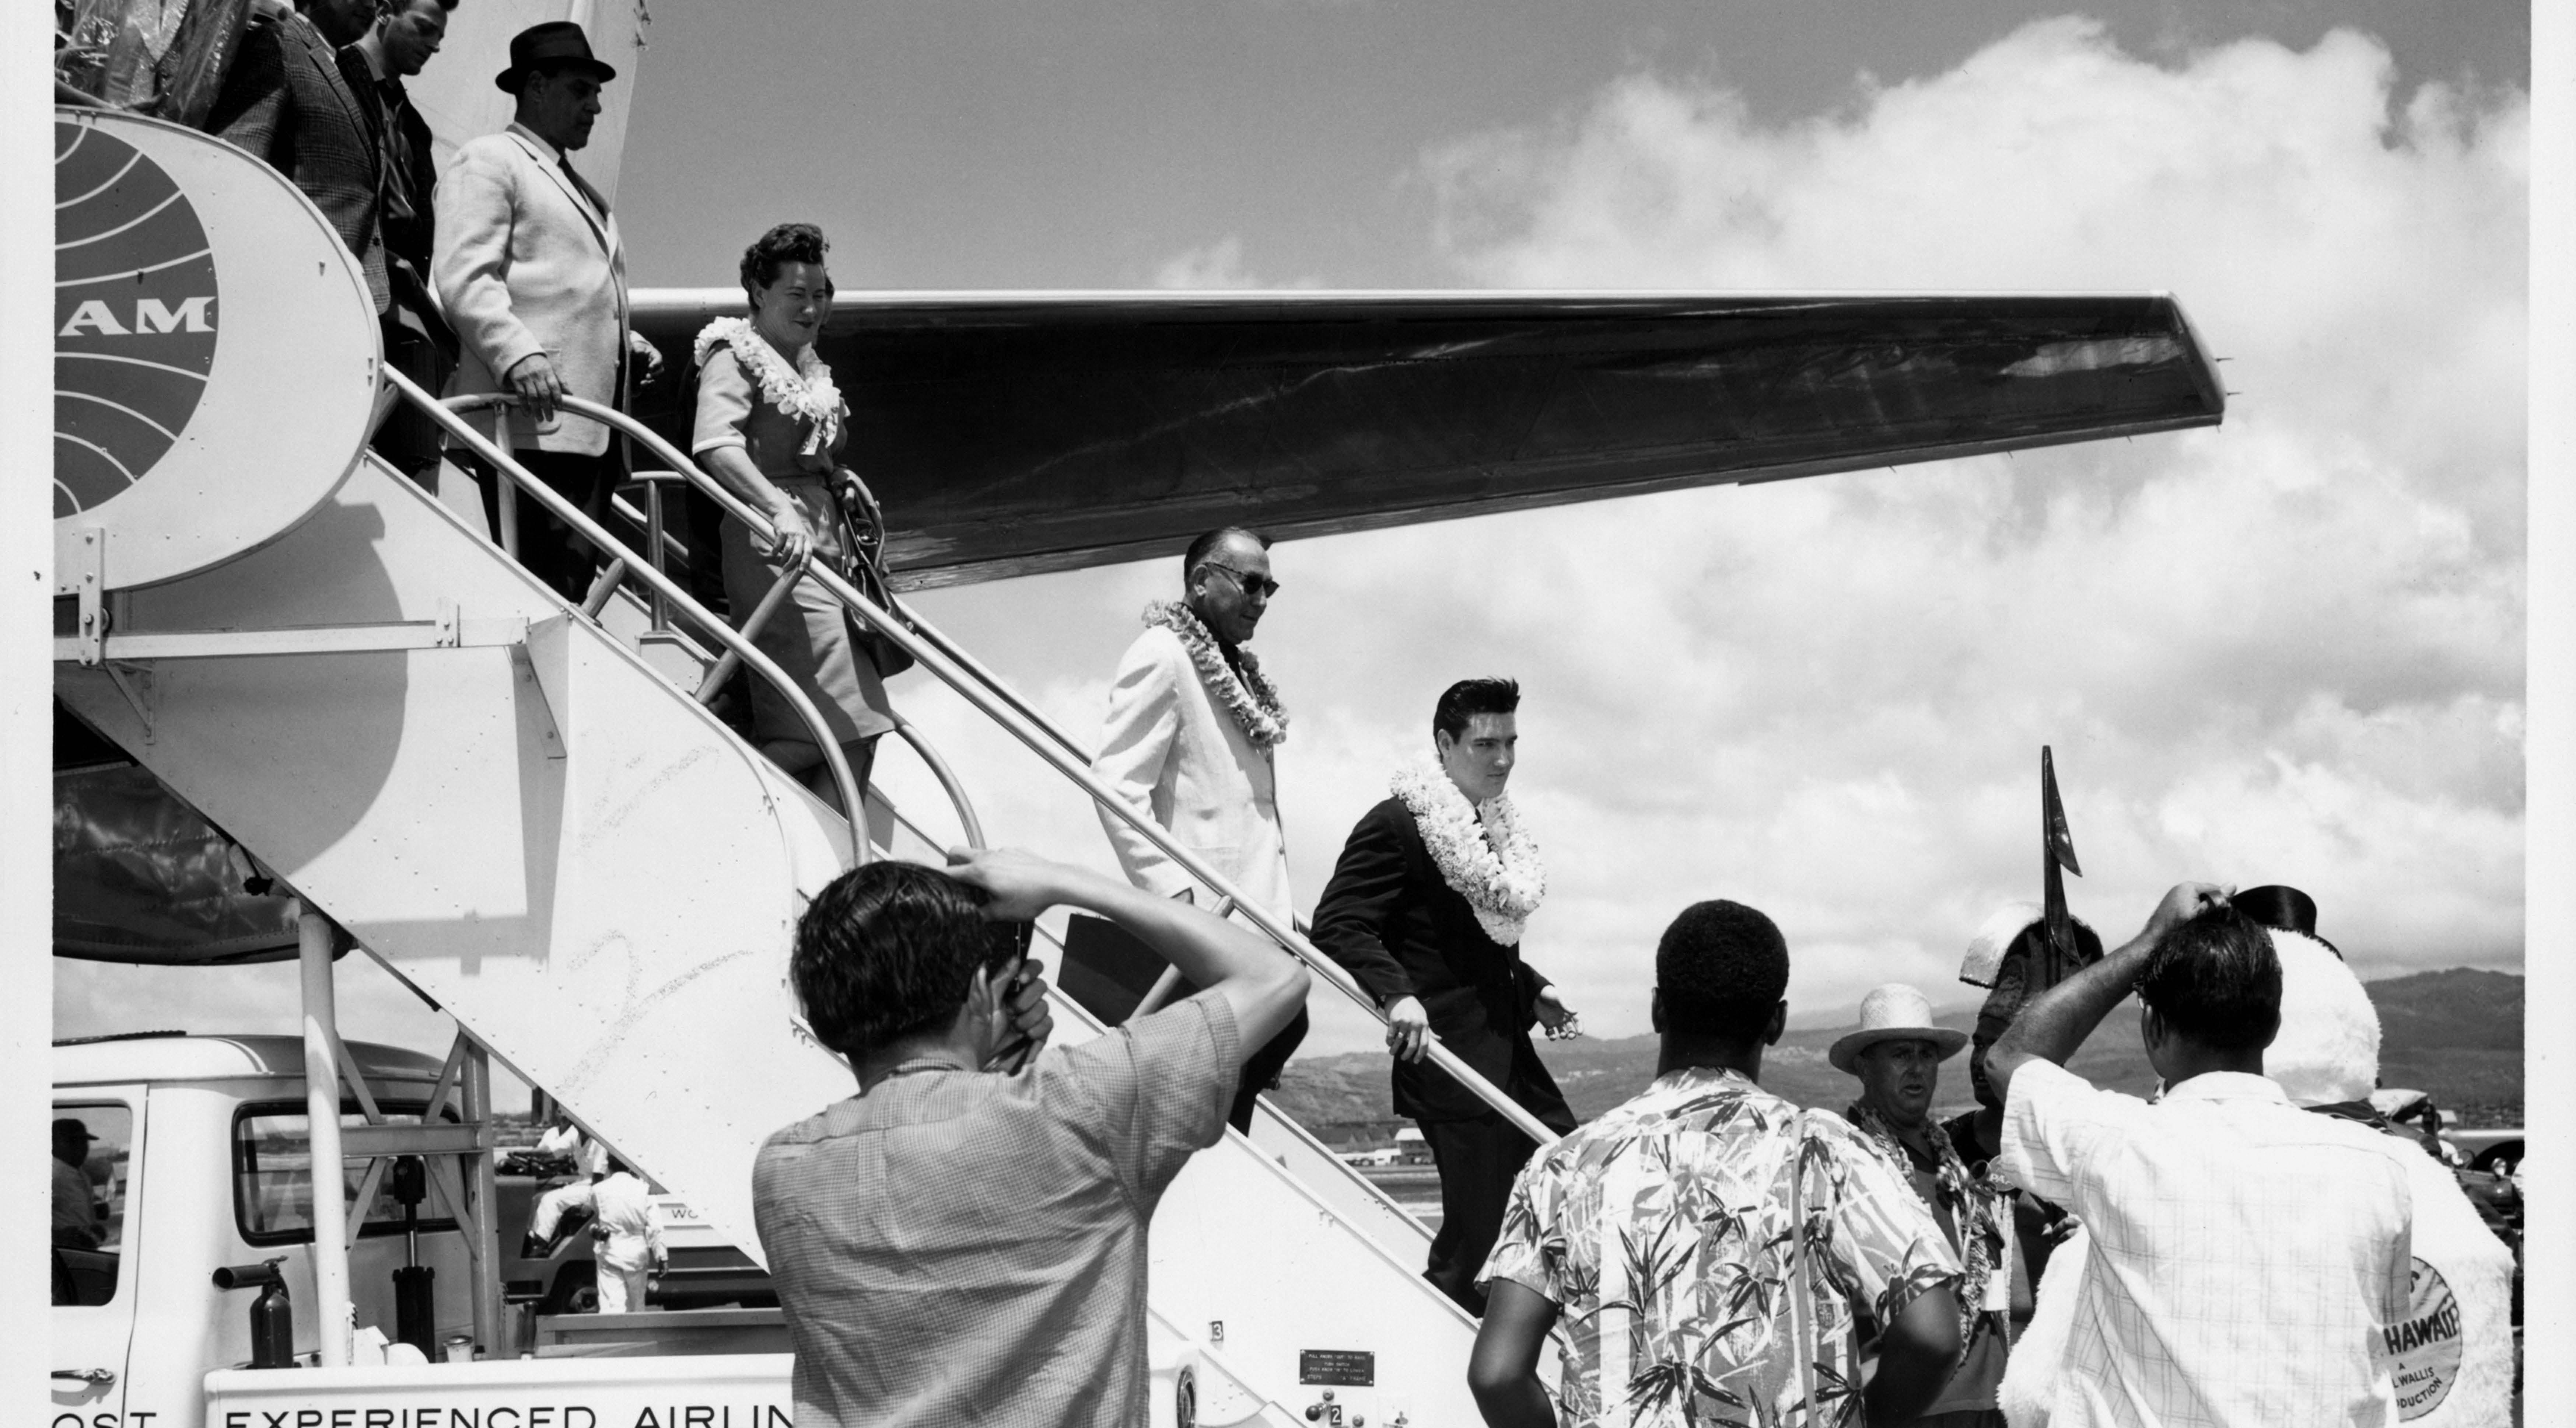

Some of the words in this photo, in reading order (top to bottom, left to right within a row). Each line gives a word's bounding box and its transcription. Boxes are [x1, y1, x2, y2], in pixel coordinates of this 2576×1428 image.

[57, 296, 216, 336] AM
[1988, 1173, 2010, 1185] PA
[1214, 1323, 1222, 1339] 3
[2383, 1308, 2457, 1355] HAWAII
[2399, 1362, 2406, 1371] A
[2398, 1366, 2435, 1386] WALLIS
[226, 1407, 596, 1428] EXPERIENCED
[1331, 1407, 1340, 1423] 2
